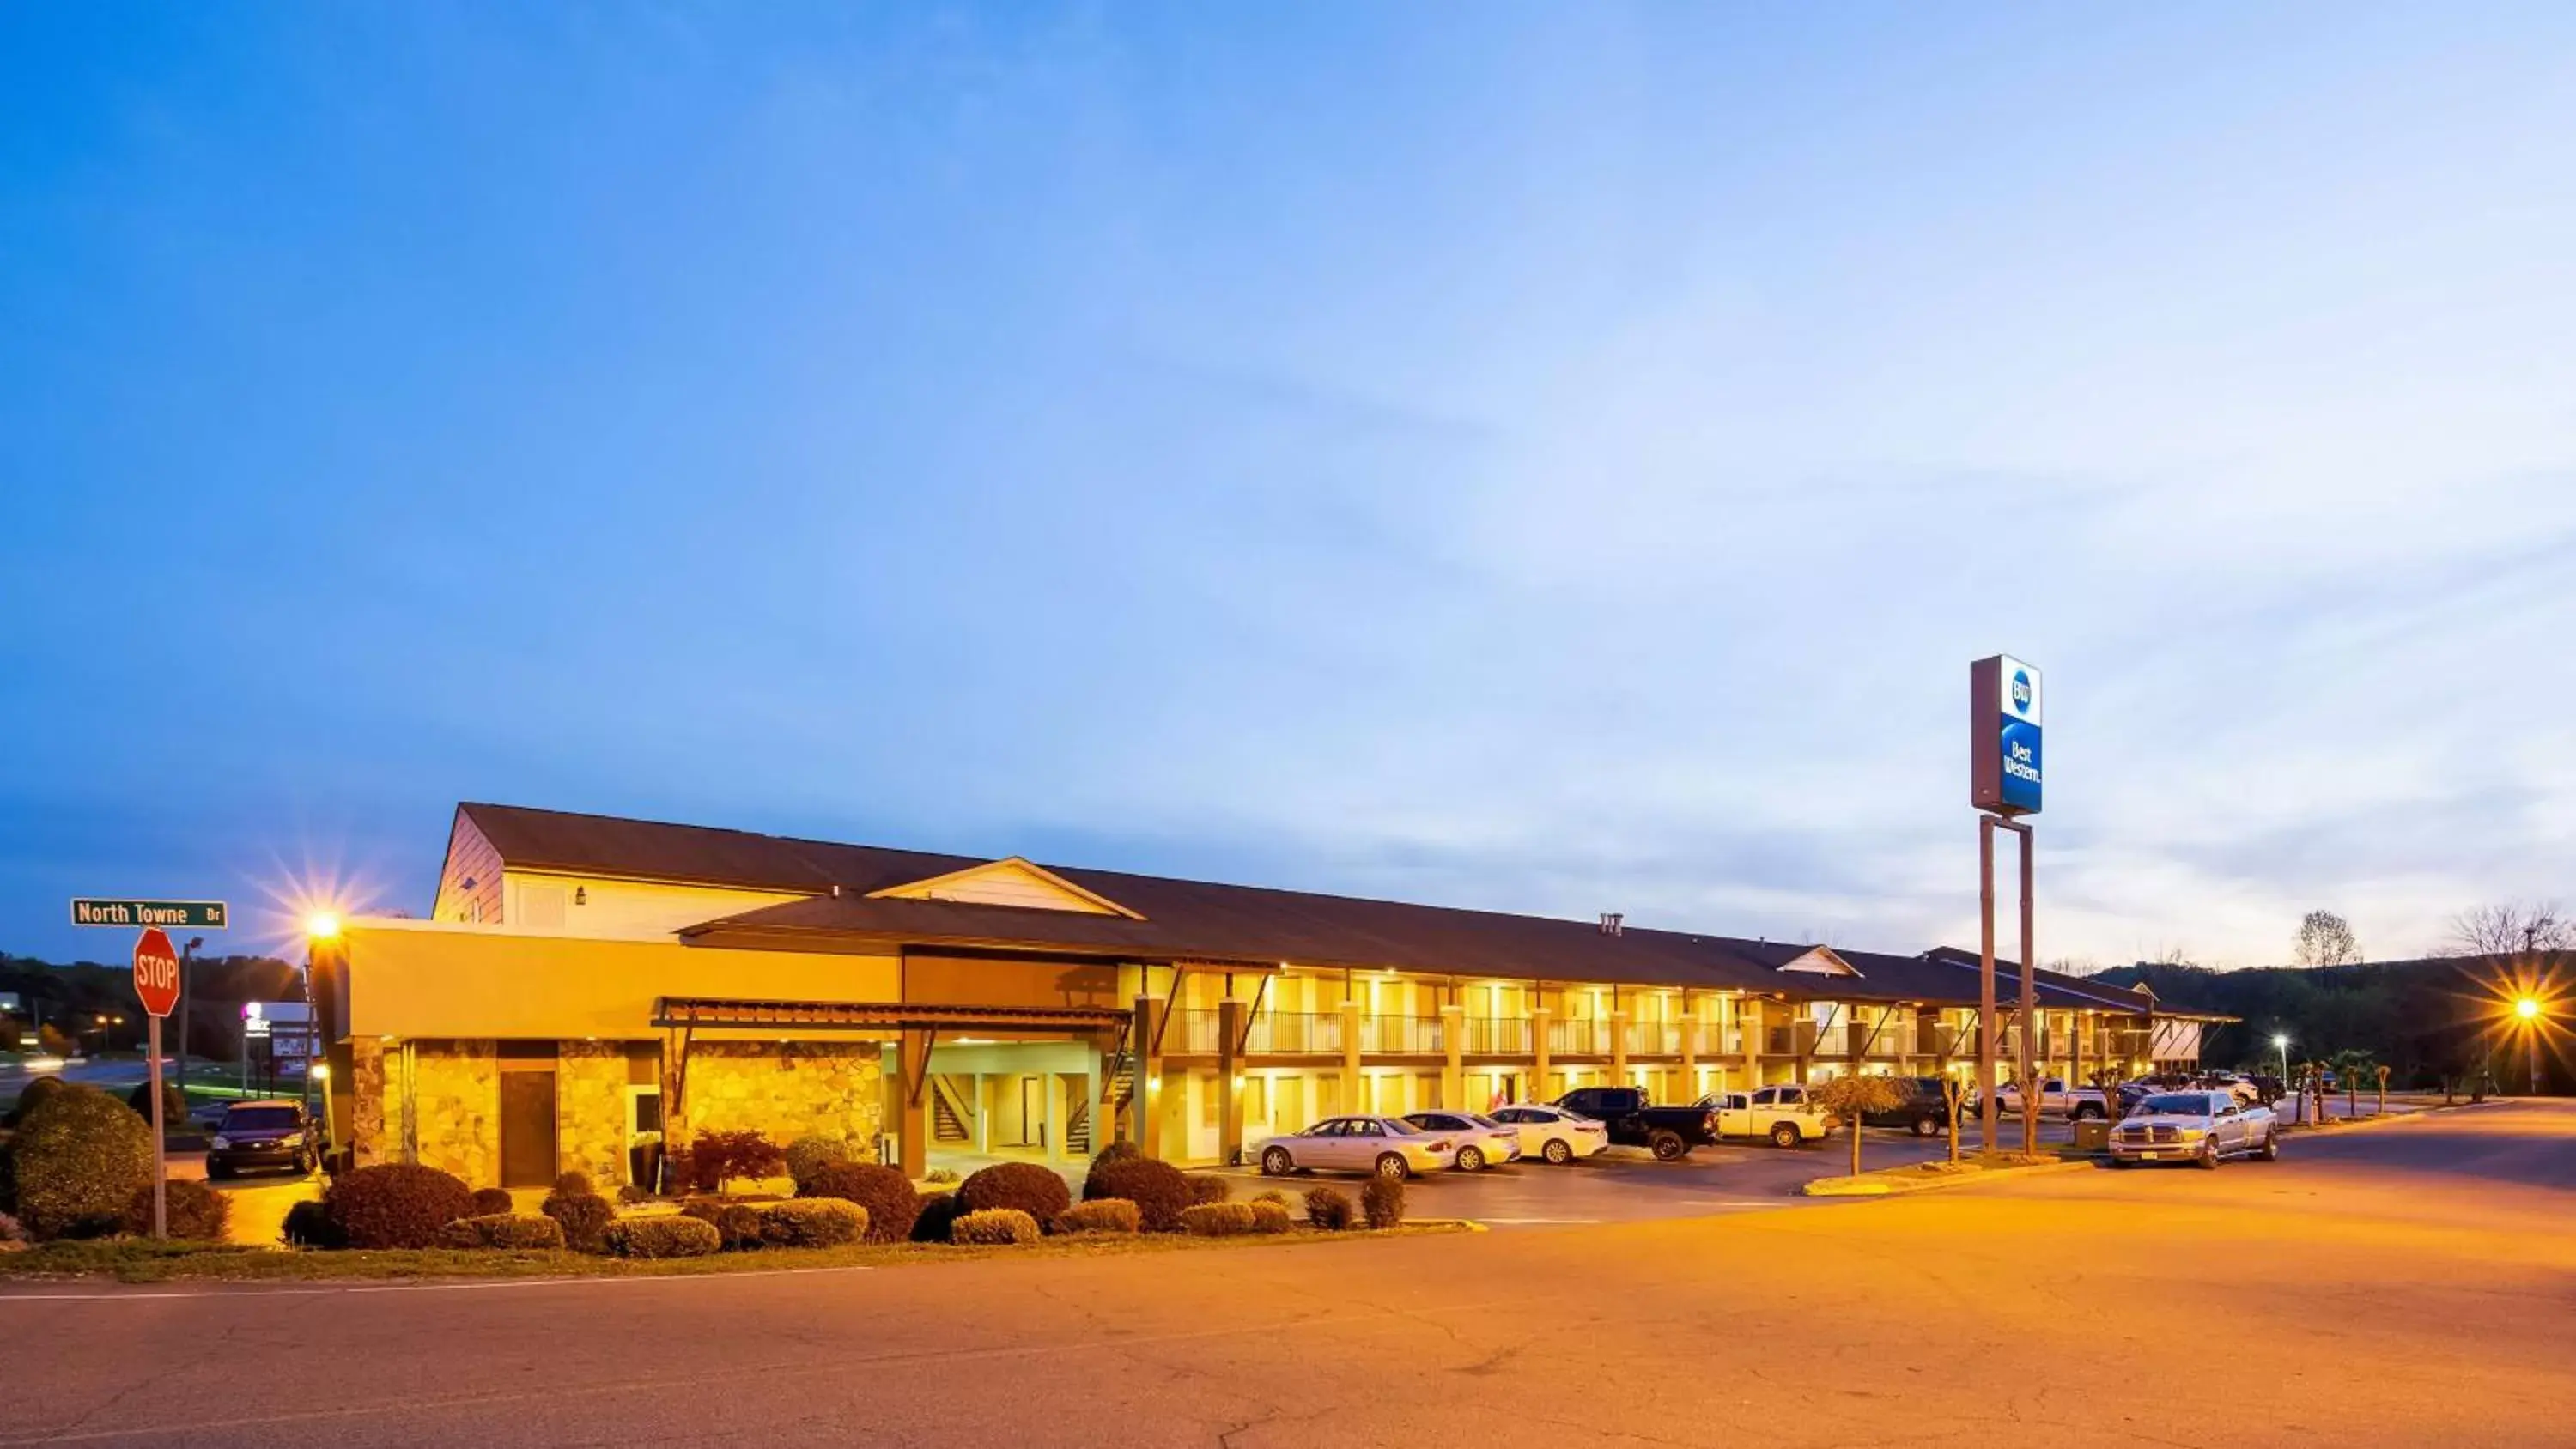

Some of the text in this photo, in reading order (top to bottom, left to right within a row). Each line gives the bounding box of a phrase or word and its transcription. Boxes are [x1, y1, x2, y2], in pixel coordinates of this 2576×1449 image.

[2013, 681, 2031, 703] BW
[2012, 741, 2032, 763] Best
[2004, 755, 2040, 783] Western
[78, 902, 221, 924] North Towne Dr
[137, 954, 176, 990] STOP
